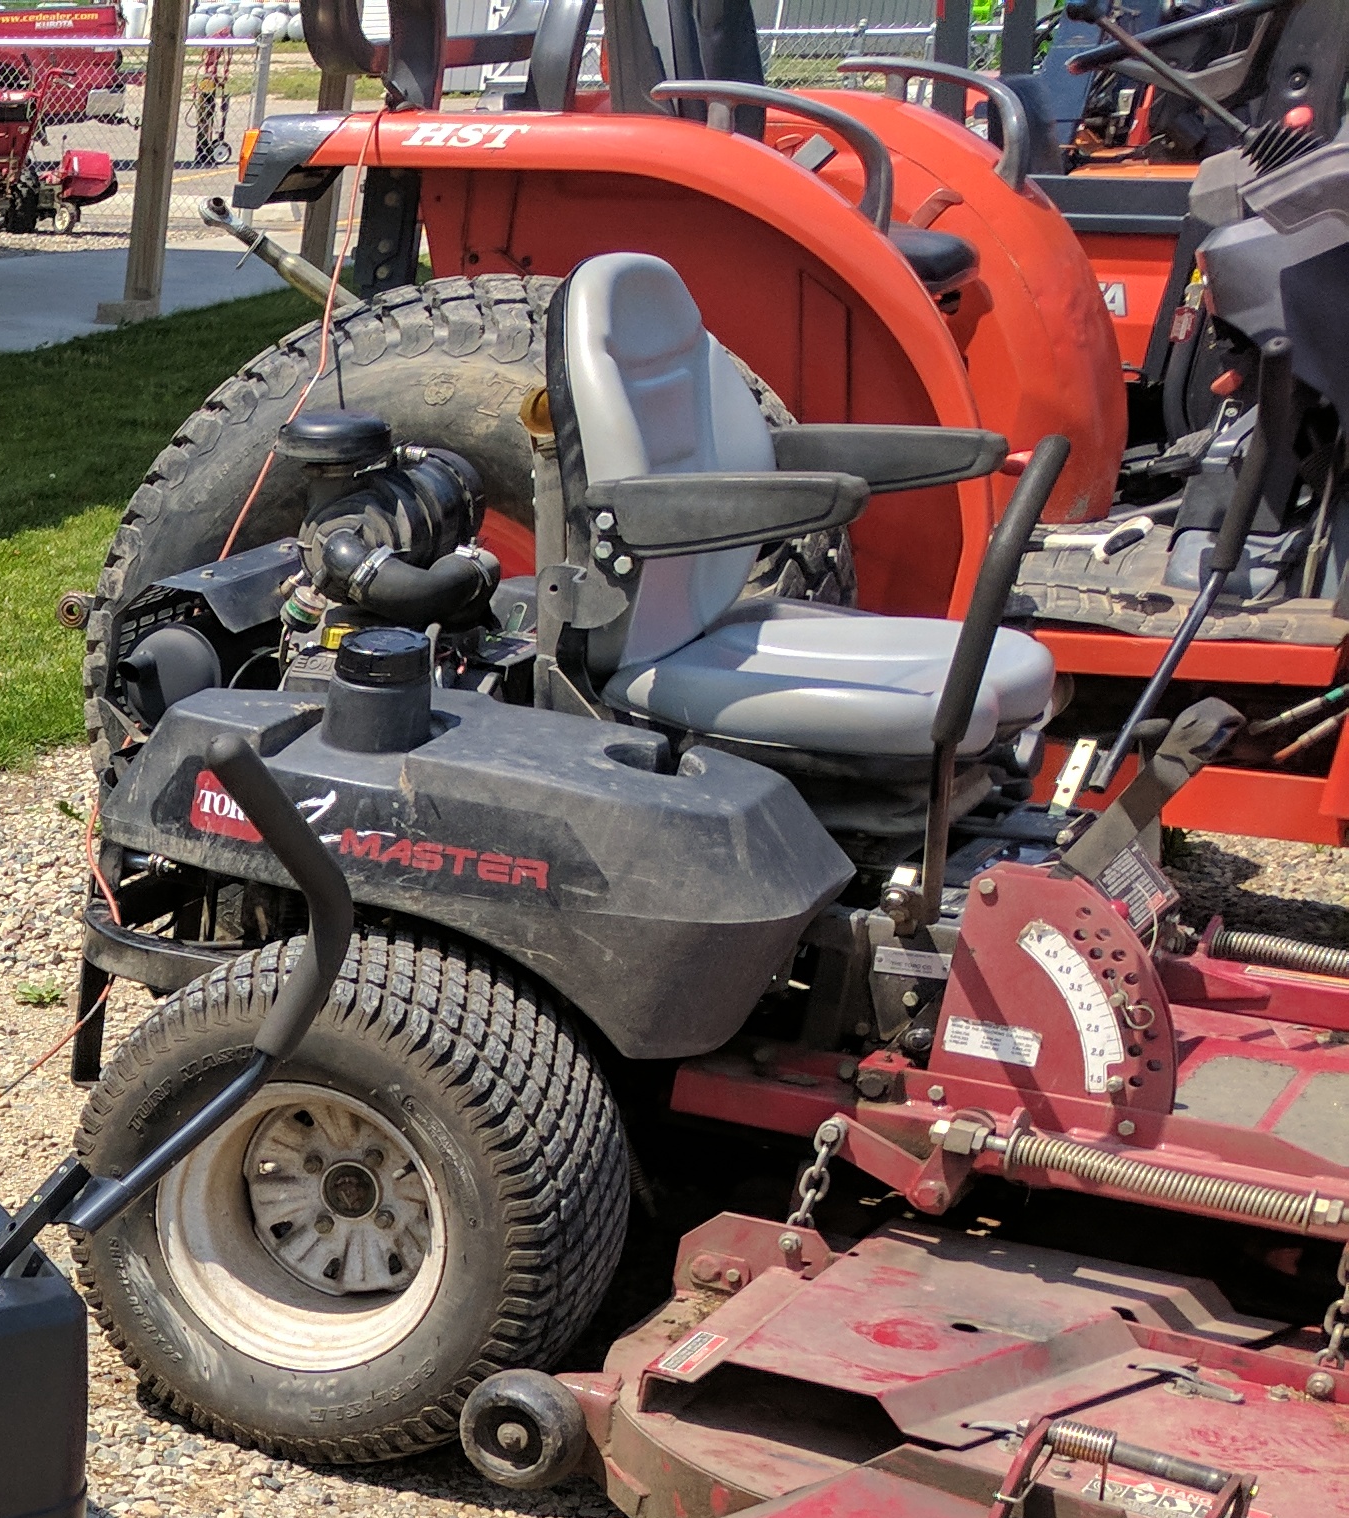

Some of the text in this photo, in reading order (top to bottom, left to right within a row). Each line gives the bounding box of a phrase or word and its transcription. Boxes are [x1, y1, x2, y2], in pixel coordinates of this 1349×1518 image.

[401, 122, 531, 149] HST
[198, 789, 249, 822] TOR
[339, 827, 550, 890] MASTER
[1028, 933, 1043, 944] 5.0
[1045, 949, 1058, 959] 4.5
[1058, 965, 1072, 975] 4.0
[1068, 983, 1083, 992] 3.5
[1078, 1002, 1092, 1011] 3.0
[1086, 1023, 1100, 1033] 2.5
[1090, 1047, 1105, 1057] 2.0
[1089, 1074, 1102, 1083] 1.5
[126, 1043, 258, 1132] TURF MAST
[1162, 1487, 1214, 1505] DANG
